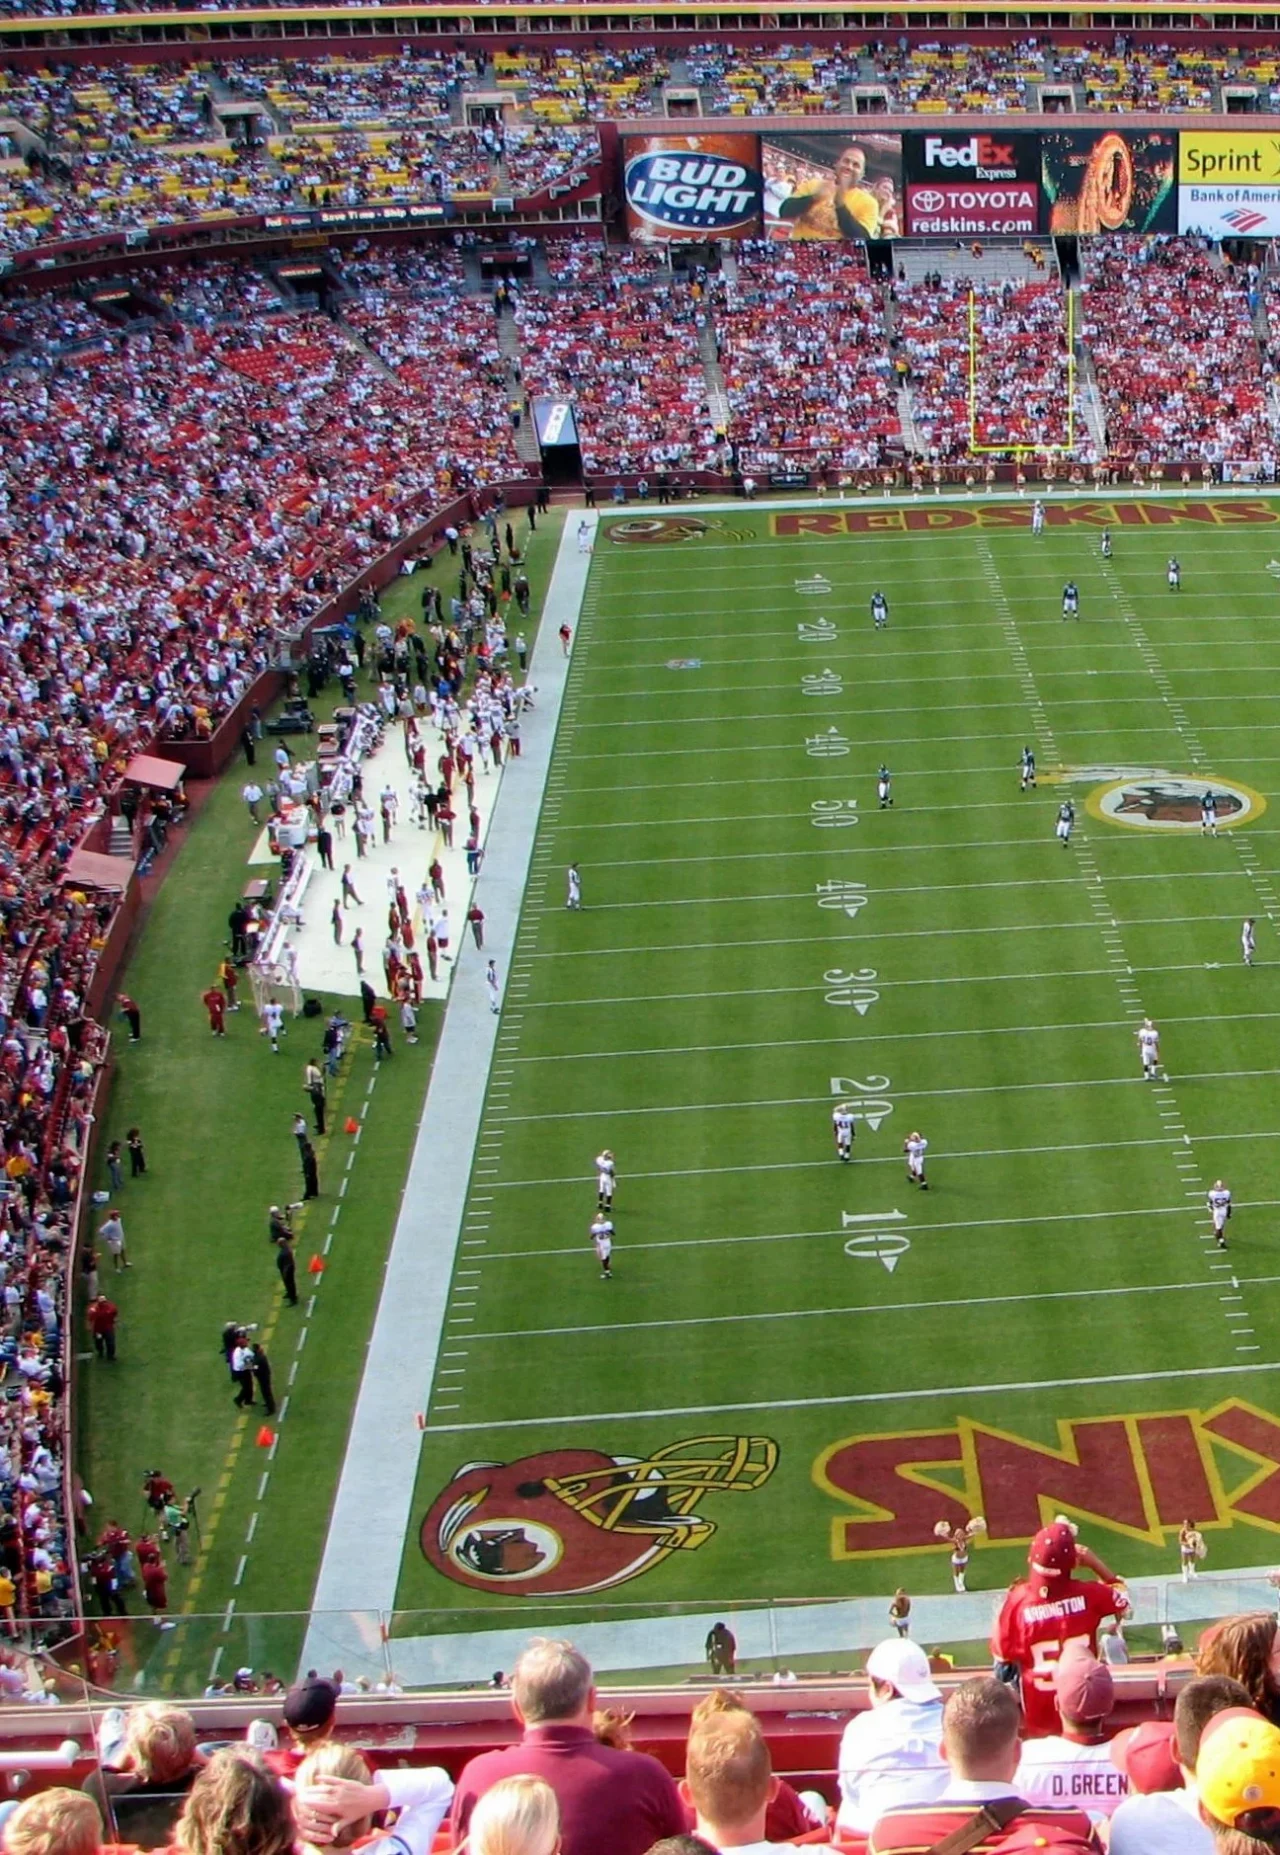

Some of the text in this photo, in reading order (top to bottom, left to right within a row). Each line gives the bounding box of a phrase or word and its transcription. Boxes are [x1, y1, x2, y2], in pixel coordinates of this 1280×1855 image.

[925, 136, 1014, 167] FedEx
[1187, 148, 1262, 178] Sprint
[649, 158, 747, 187] BUD
[976, 167, 1017, 180] Express
[631, 180, 755, 214] LIGHT
[946, 191, 1033, 209] TOYOTA
[1191, 189, 1224, 202] Bank
[1226, 189, 1240, 202] of
[912, 217, 1033, 234] redskins.com
[798, 622, 837, 641] 20
[801, 674, 843, 695] 30
[806, 734, 850, 756] 40
[811, 799, 859, 827] 50
[816, 879, 868, 909] 40
[823, 968, 879, 1005] 30
[830, 1075, 893, 1119] 20
[842, 1208, 911, 1257] 10
